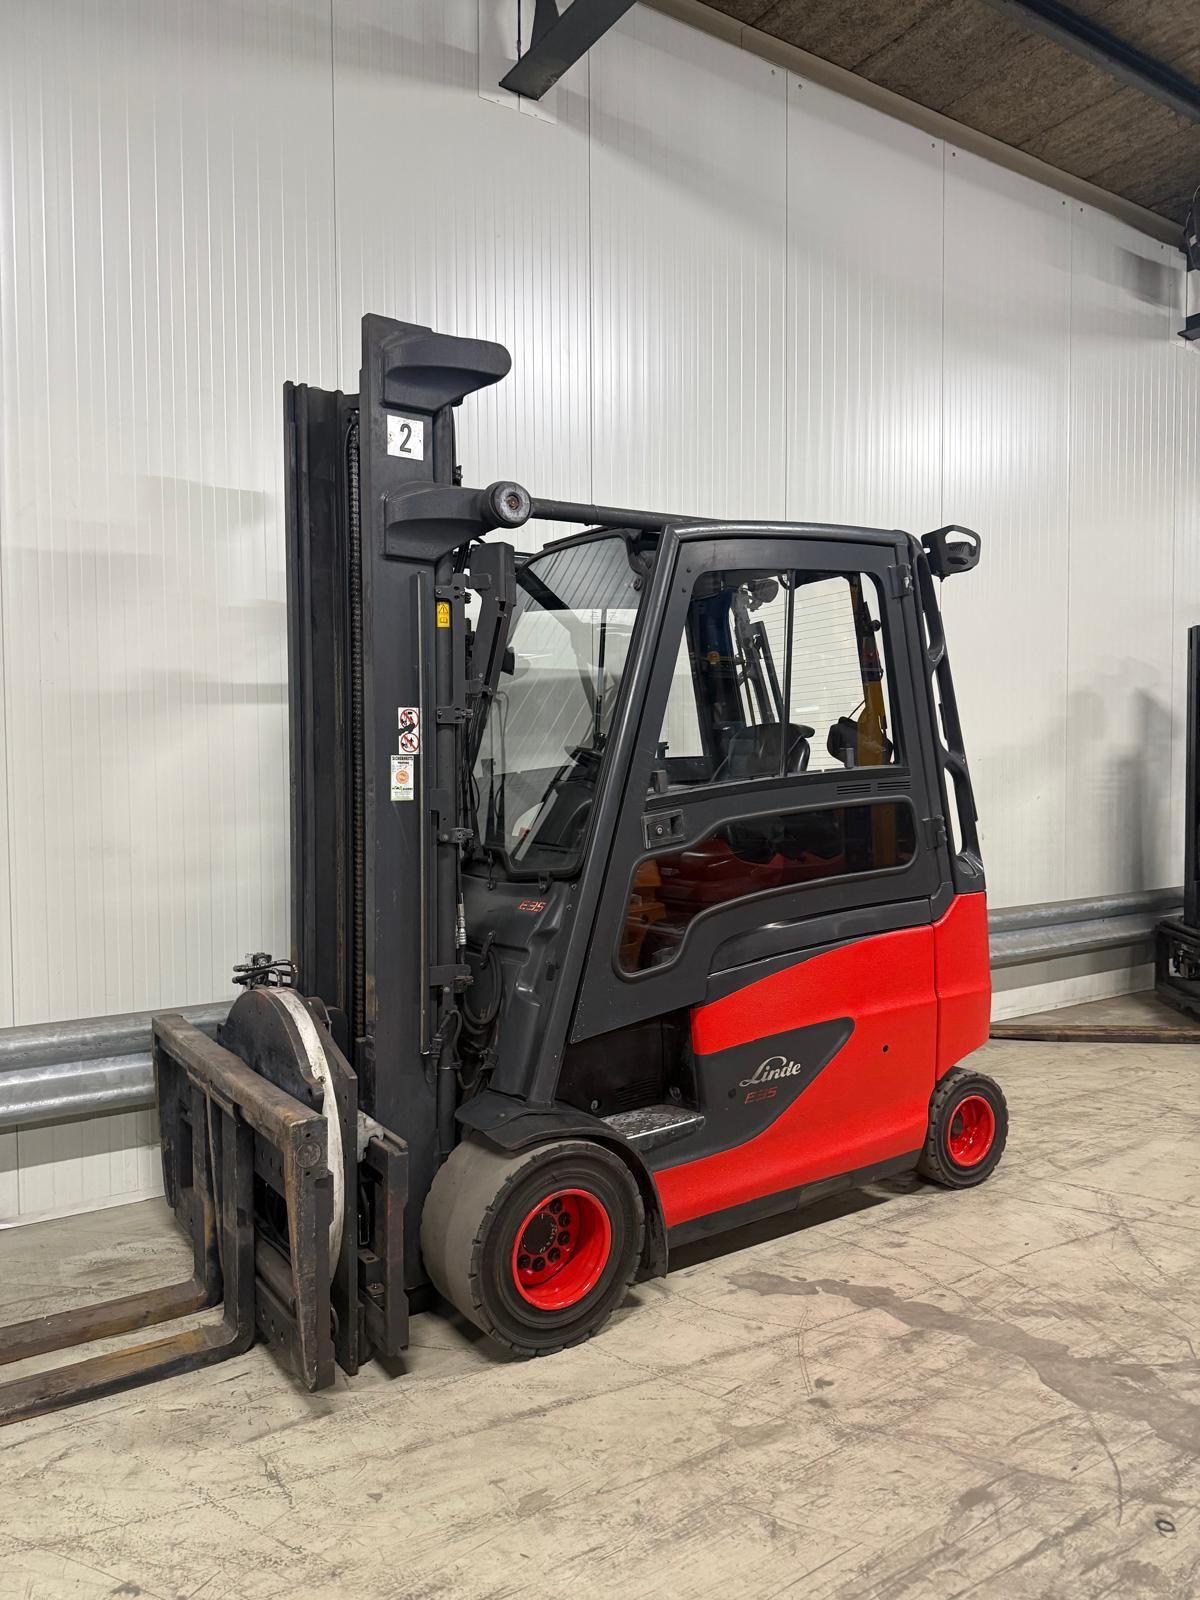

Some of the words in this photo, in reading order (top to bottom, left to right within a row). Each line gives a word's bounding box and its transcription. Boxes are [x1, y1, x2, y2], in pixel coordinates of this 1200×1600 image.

[400, 423, 412, 454] 2
[518, 900, 547, 912] E35
[739, 1056, 801, 1087] Linde
